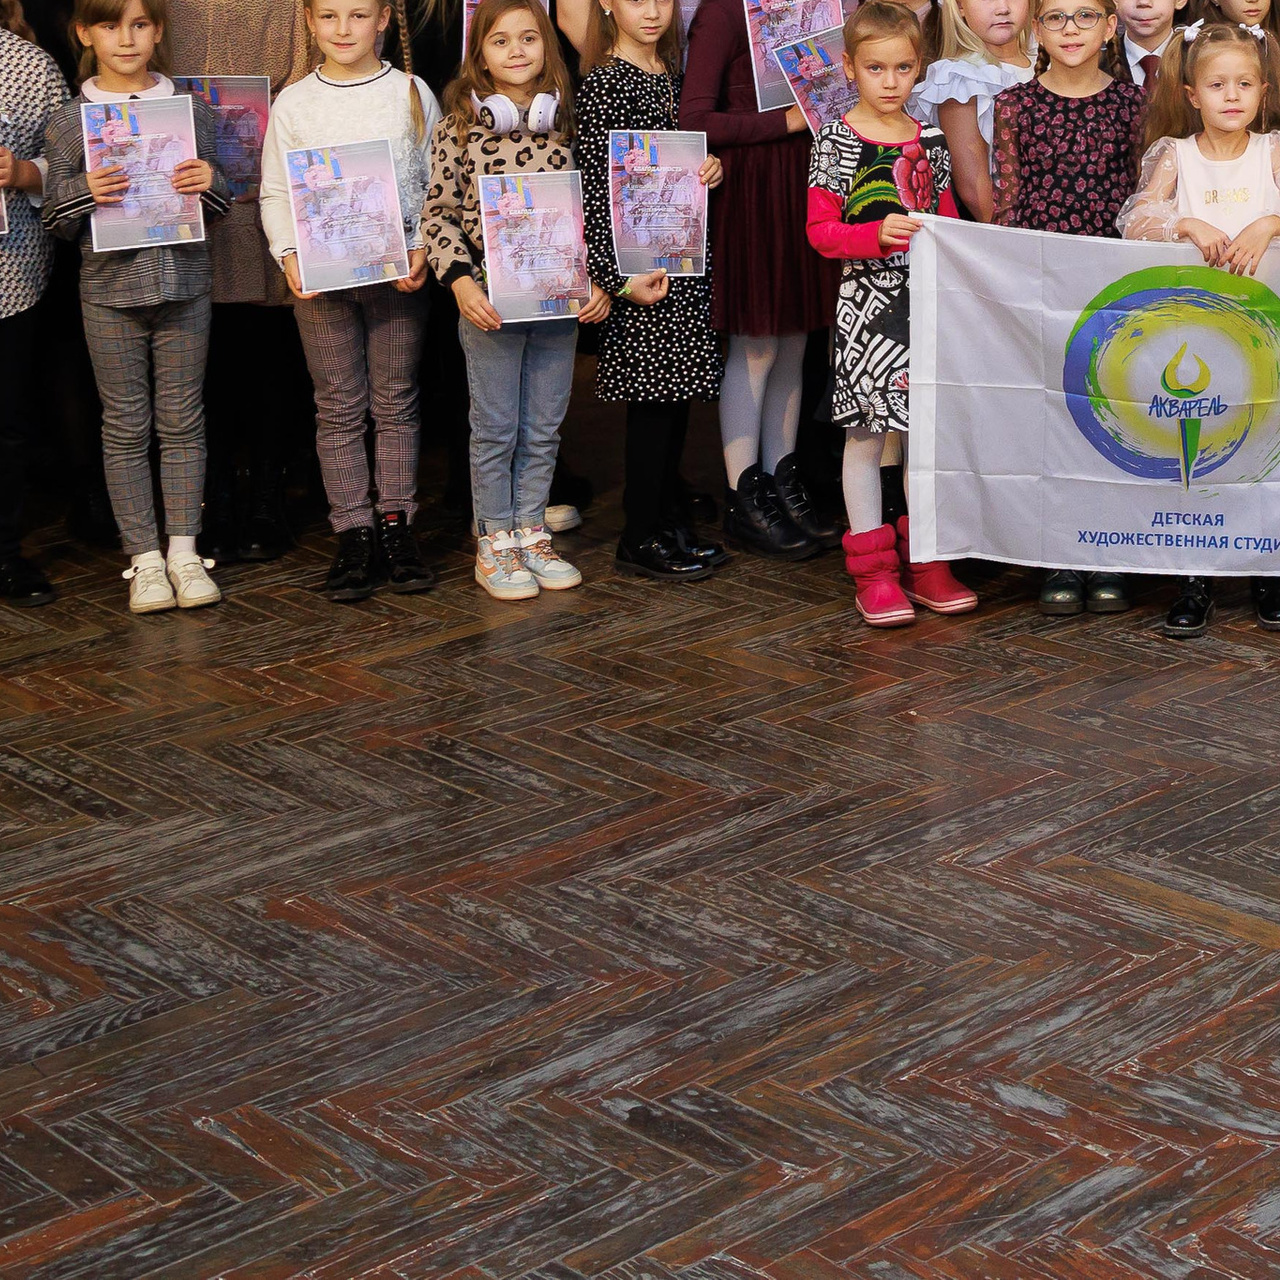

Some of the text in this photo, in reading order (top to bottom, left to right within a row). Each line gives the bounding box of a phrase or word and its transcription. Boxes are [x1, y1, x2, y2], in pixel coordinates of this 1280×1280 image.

[1148, 394, 1229, 419] АКВАРЕЛЬ
[1151, 511, 1225, 528] ДЕТСКАЯ
[1077, 530, 1229, 549] ХУДОЖЕСТВЕННАЯ
